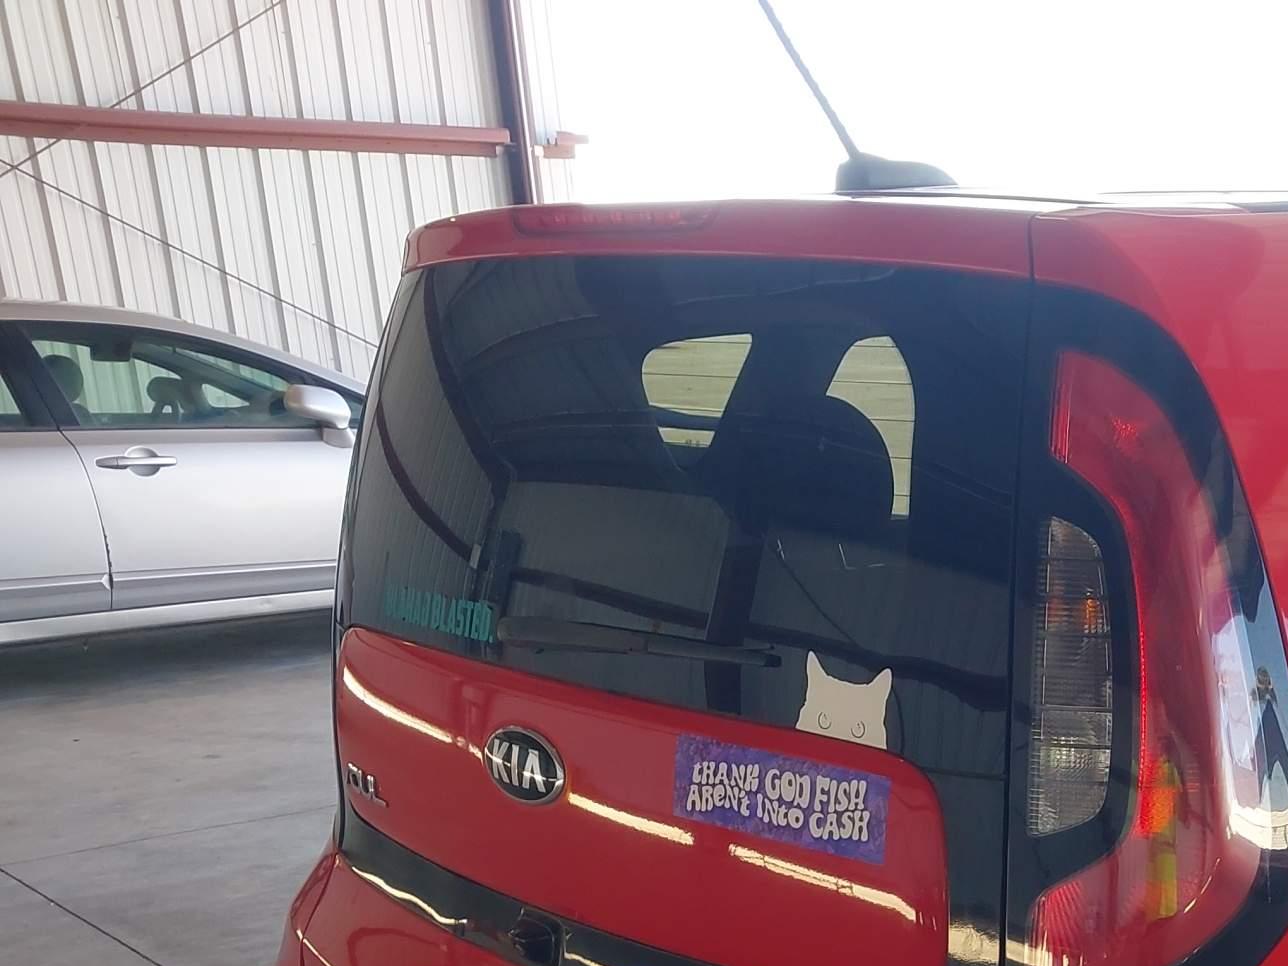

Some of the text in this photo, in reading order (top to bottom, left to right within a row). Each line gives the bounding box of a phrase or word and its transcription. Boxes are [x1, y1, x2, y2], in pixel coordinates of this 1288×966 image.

[346, 762, 388, 807] OUL
[492, 738, 546, 793] KIA
[764, 768, 811, 808] GOD
[814, 775, 867, 812] FISH
[809, 810, 870, 842] CASH
